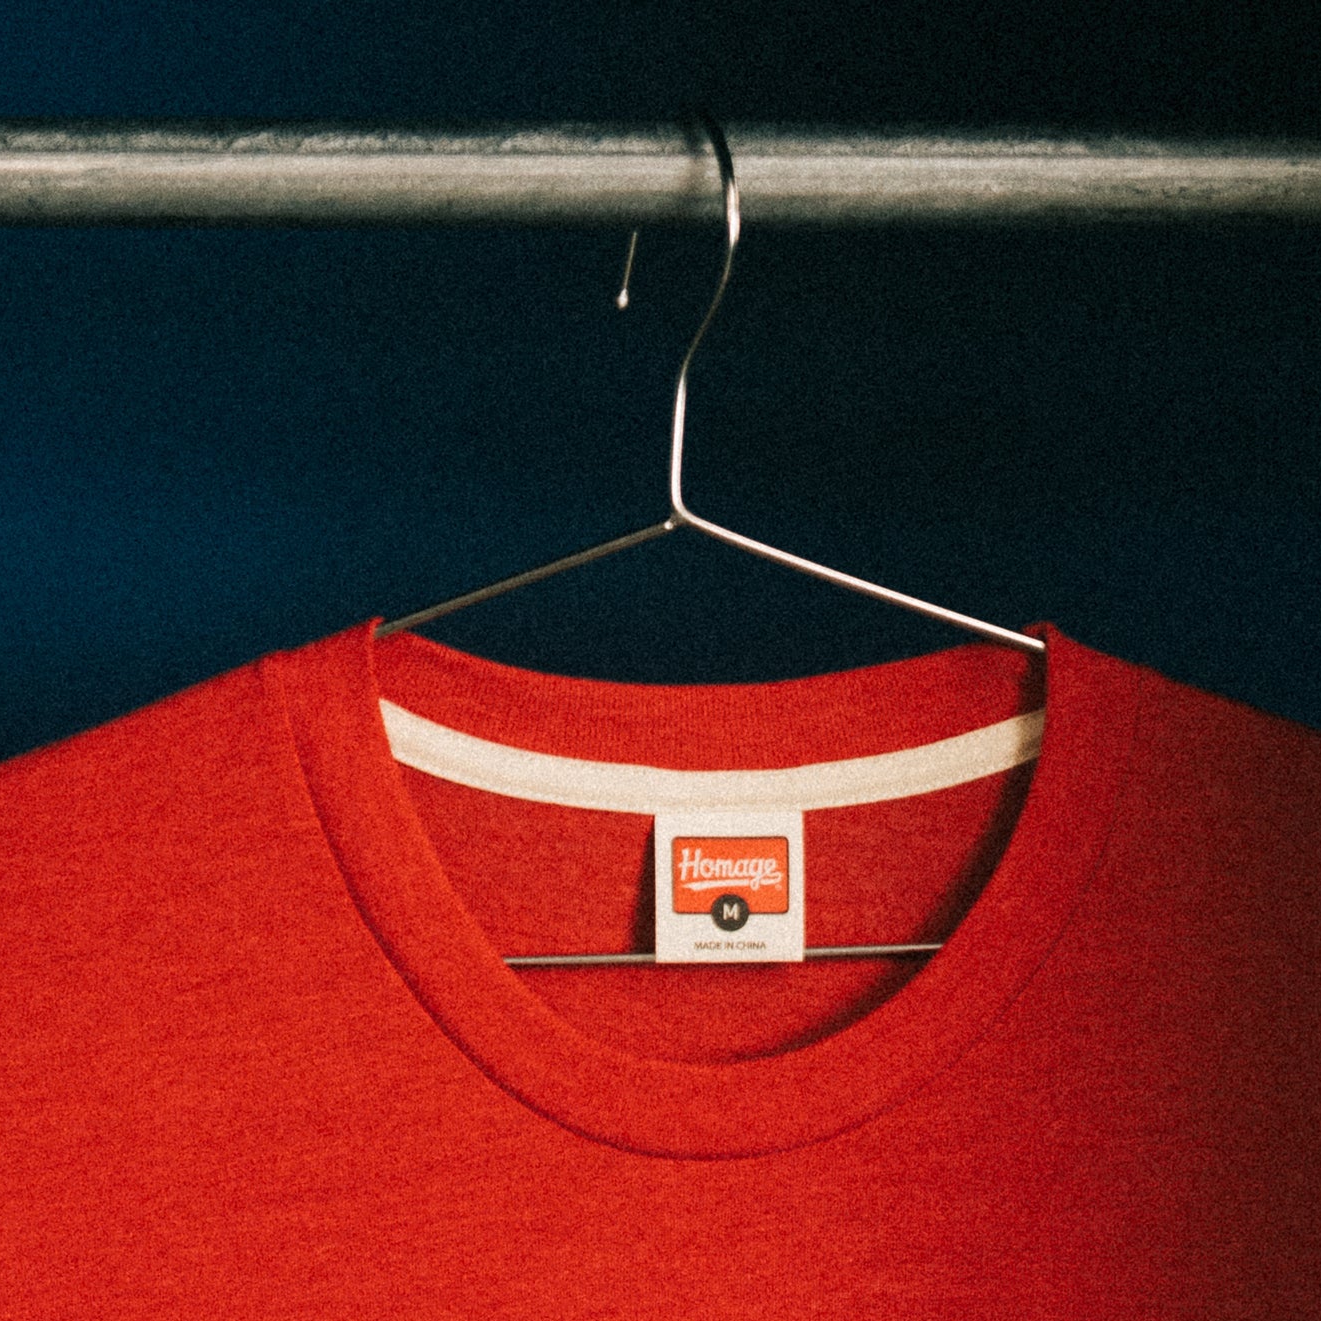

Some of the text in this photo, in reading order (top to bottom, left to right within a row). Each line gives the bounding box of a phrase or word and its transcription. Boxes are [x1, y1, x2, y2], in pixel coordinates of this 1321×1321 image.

[679, 847, 783, 892] Homage
[723, 904, 740, 921] M
[694, 941, 767, 950] MADE IN CHINA
